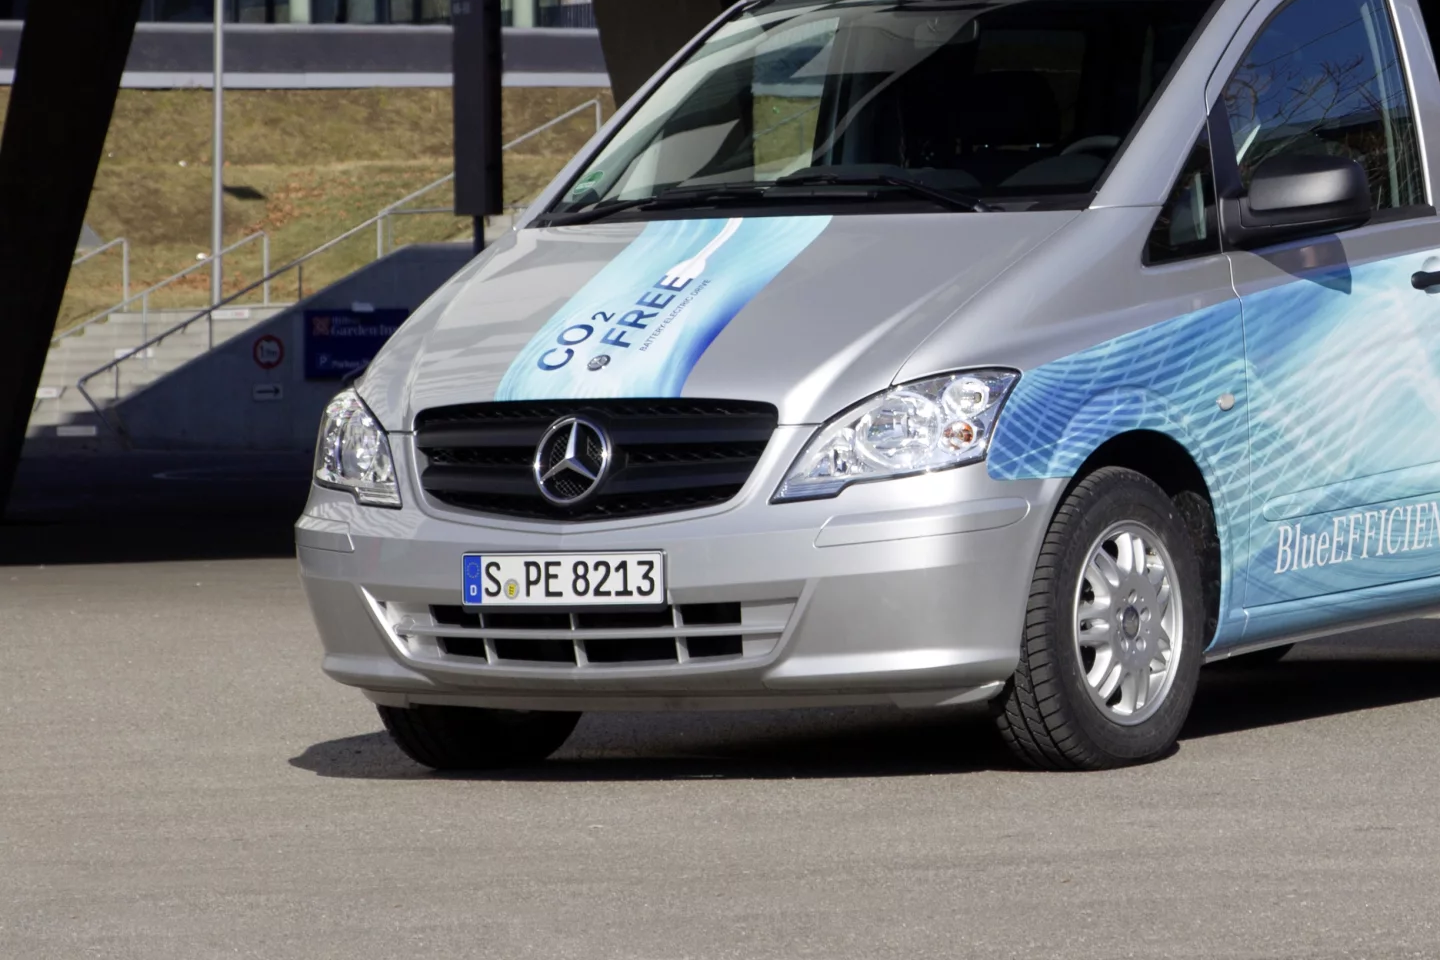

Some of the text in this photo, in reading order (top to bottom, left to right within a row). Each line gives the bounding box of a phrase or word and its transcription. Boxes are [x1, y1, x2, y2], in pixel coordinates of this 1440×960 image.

[690, 279, 711, 296] DRIVE
[600, 275, 693, 349] FREE
[330, 324, 377, 337] Garden
[484, 560, 656, 597] S PE 8213
[470, 584, 477, 596] D
